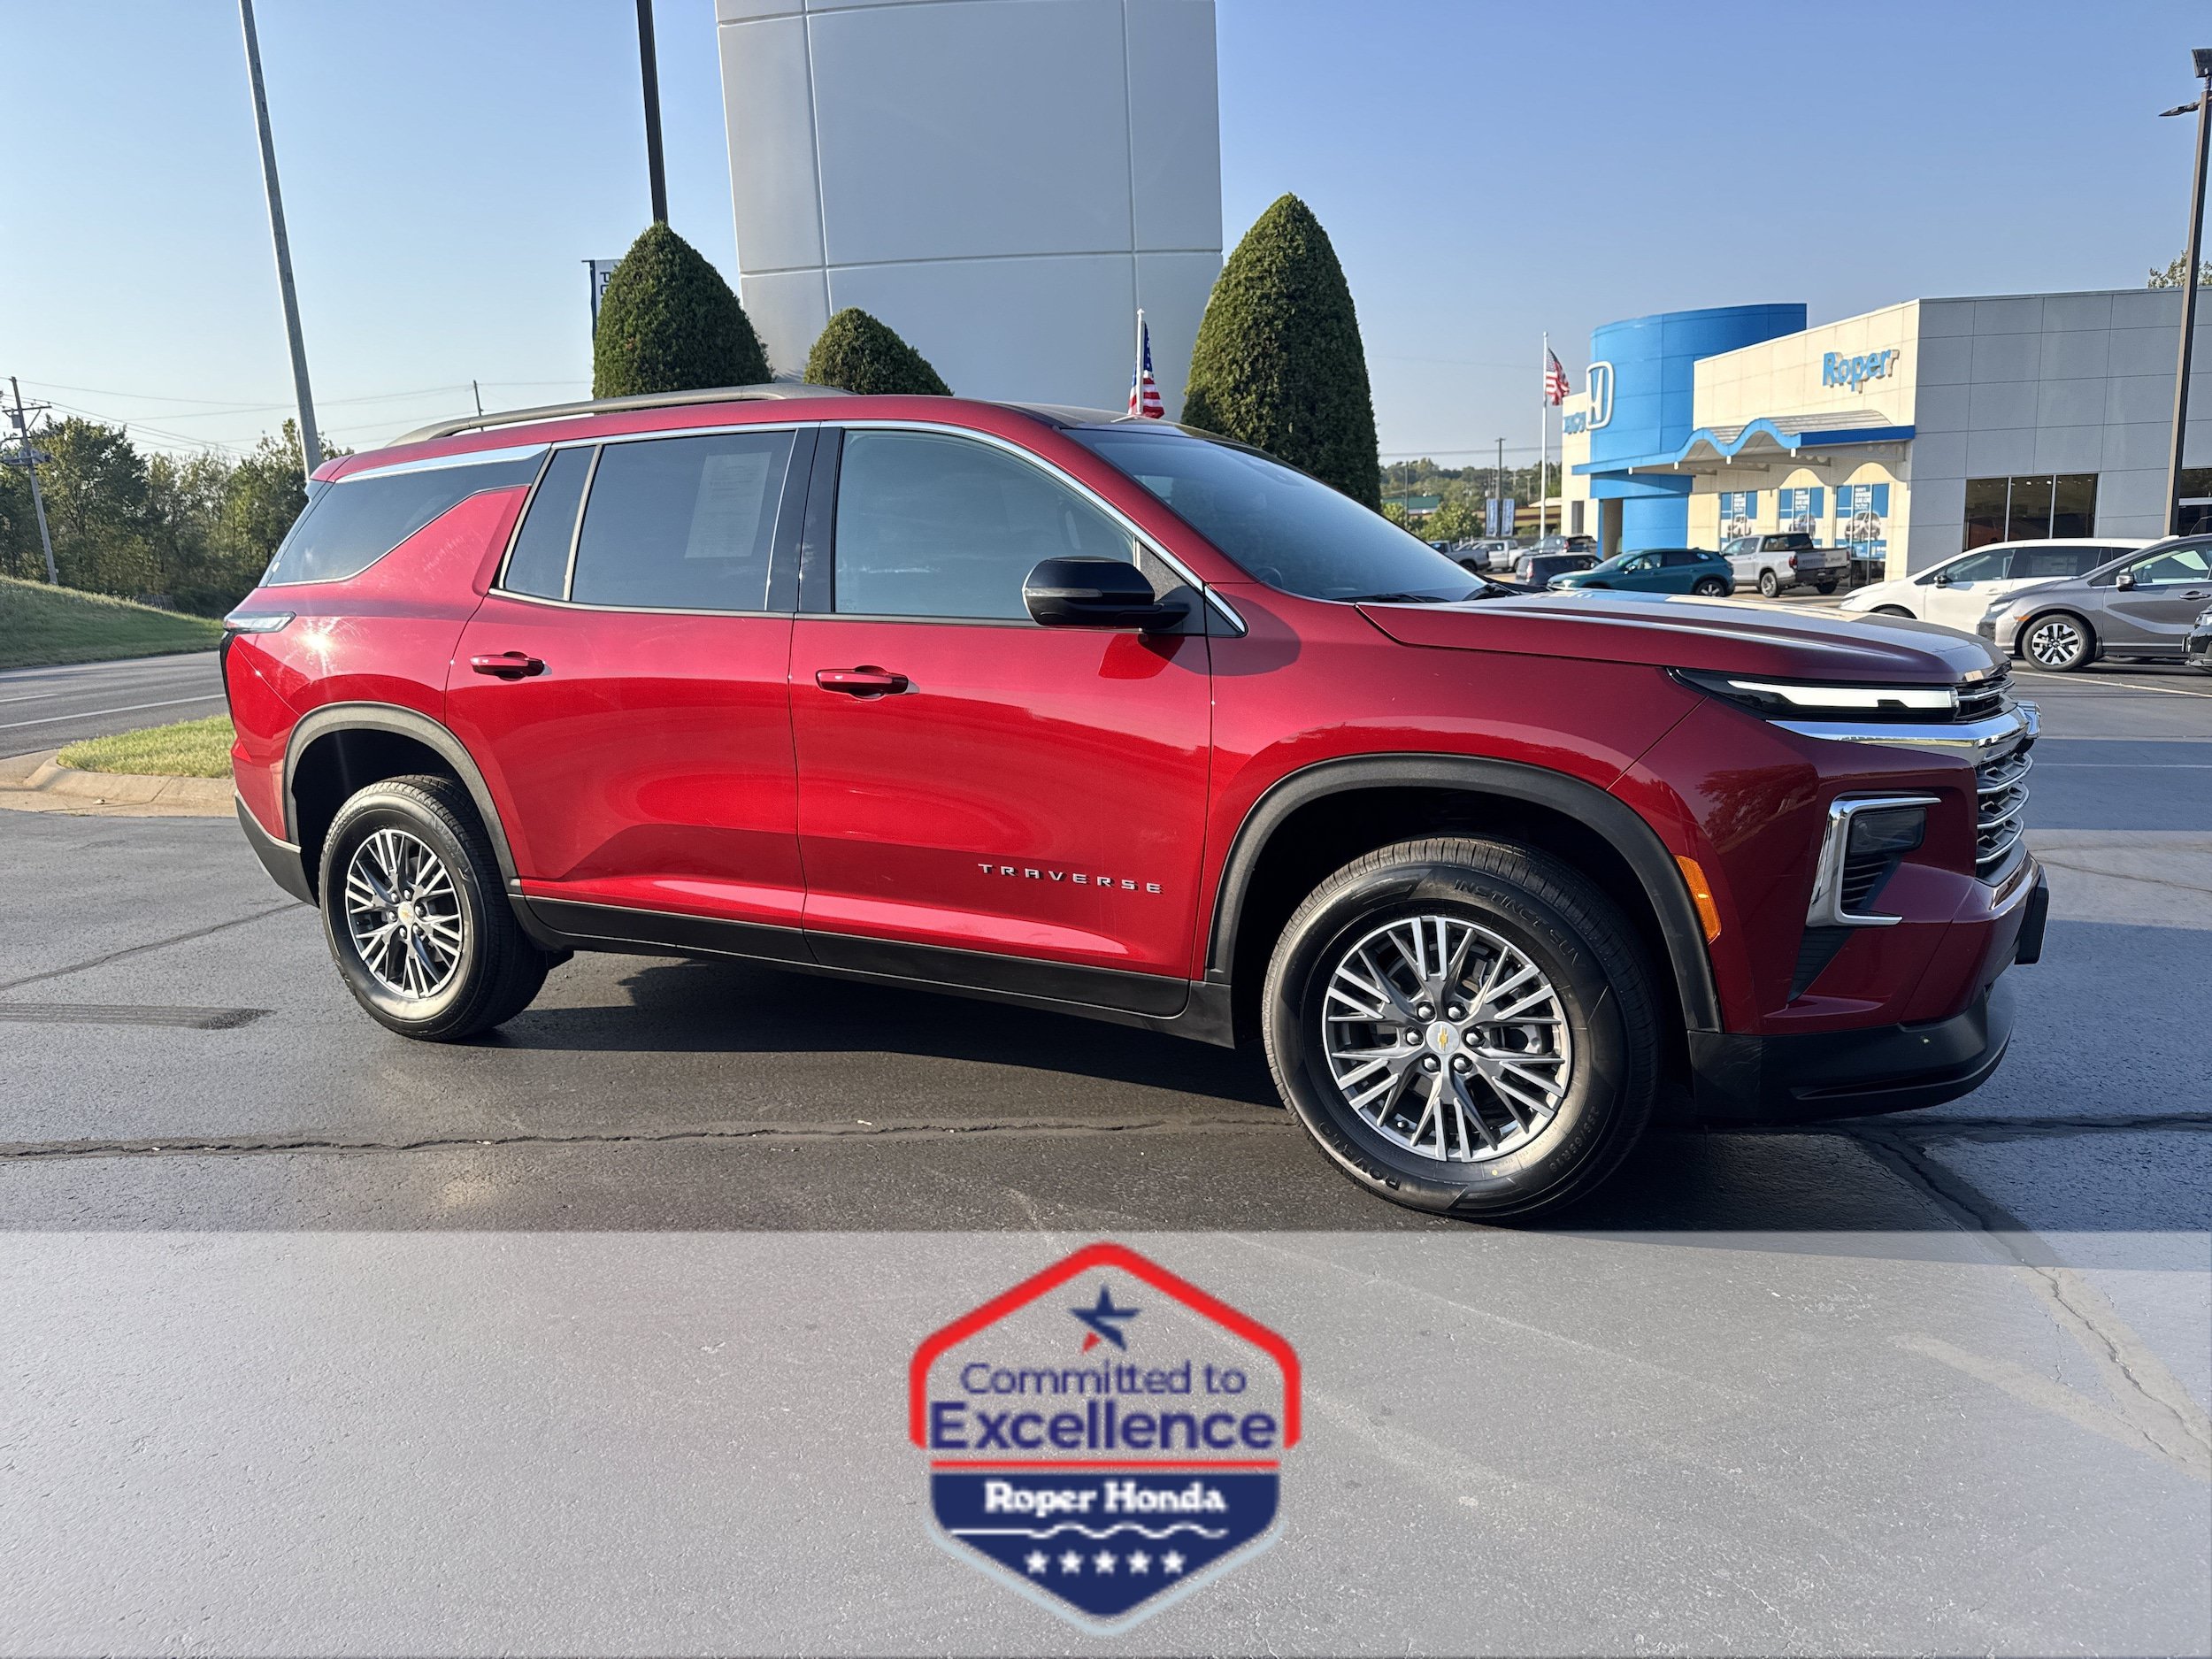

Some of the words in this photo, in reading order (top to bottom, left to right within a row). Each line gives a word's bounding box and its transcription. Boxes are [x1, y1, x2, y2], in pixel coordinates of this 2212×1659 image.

[1823, 349, 1895, 392] Roper
[978, 863, 1162, 894] TRAVERSE
[1454, 879, 1549, 928] INSTINCT
